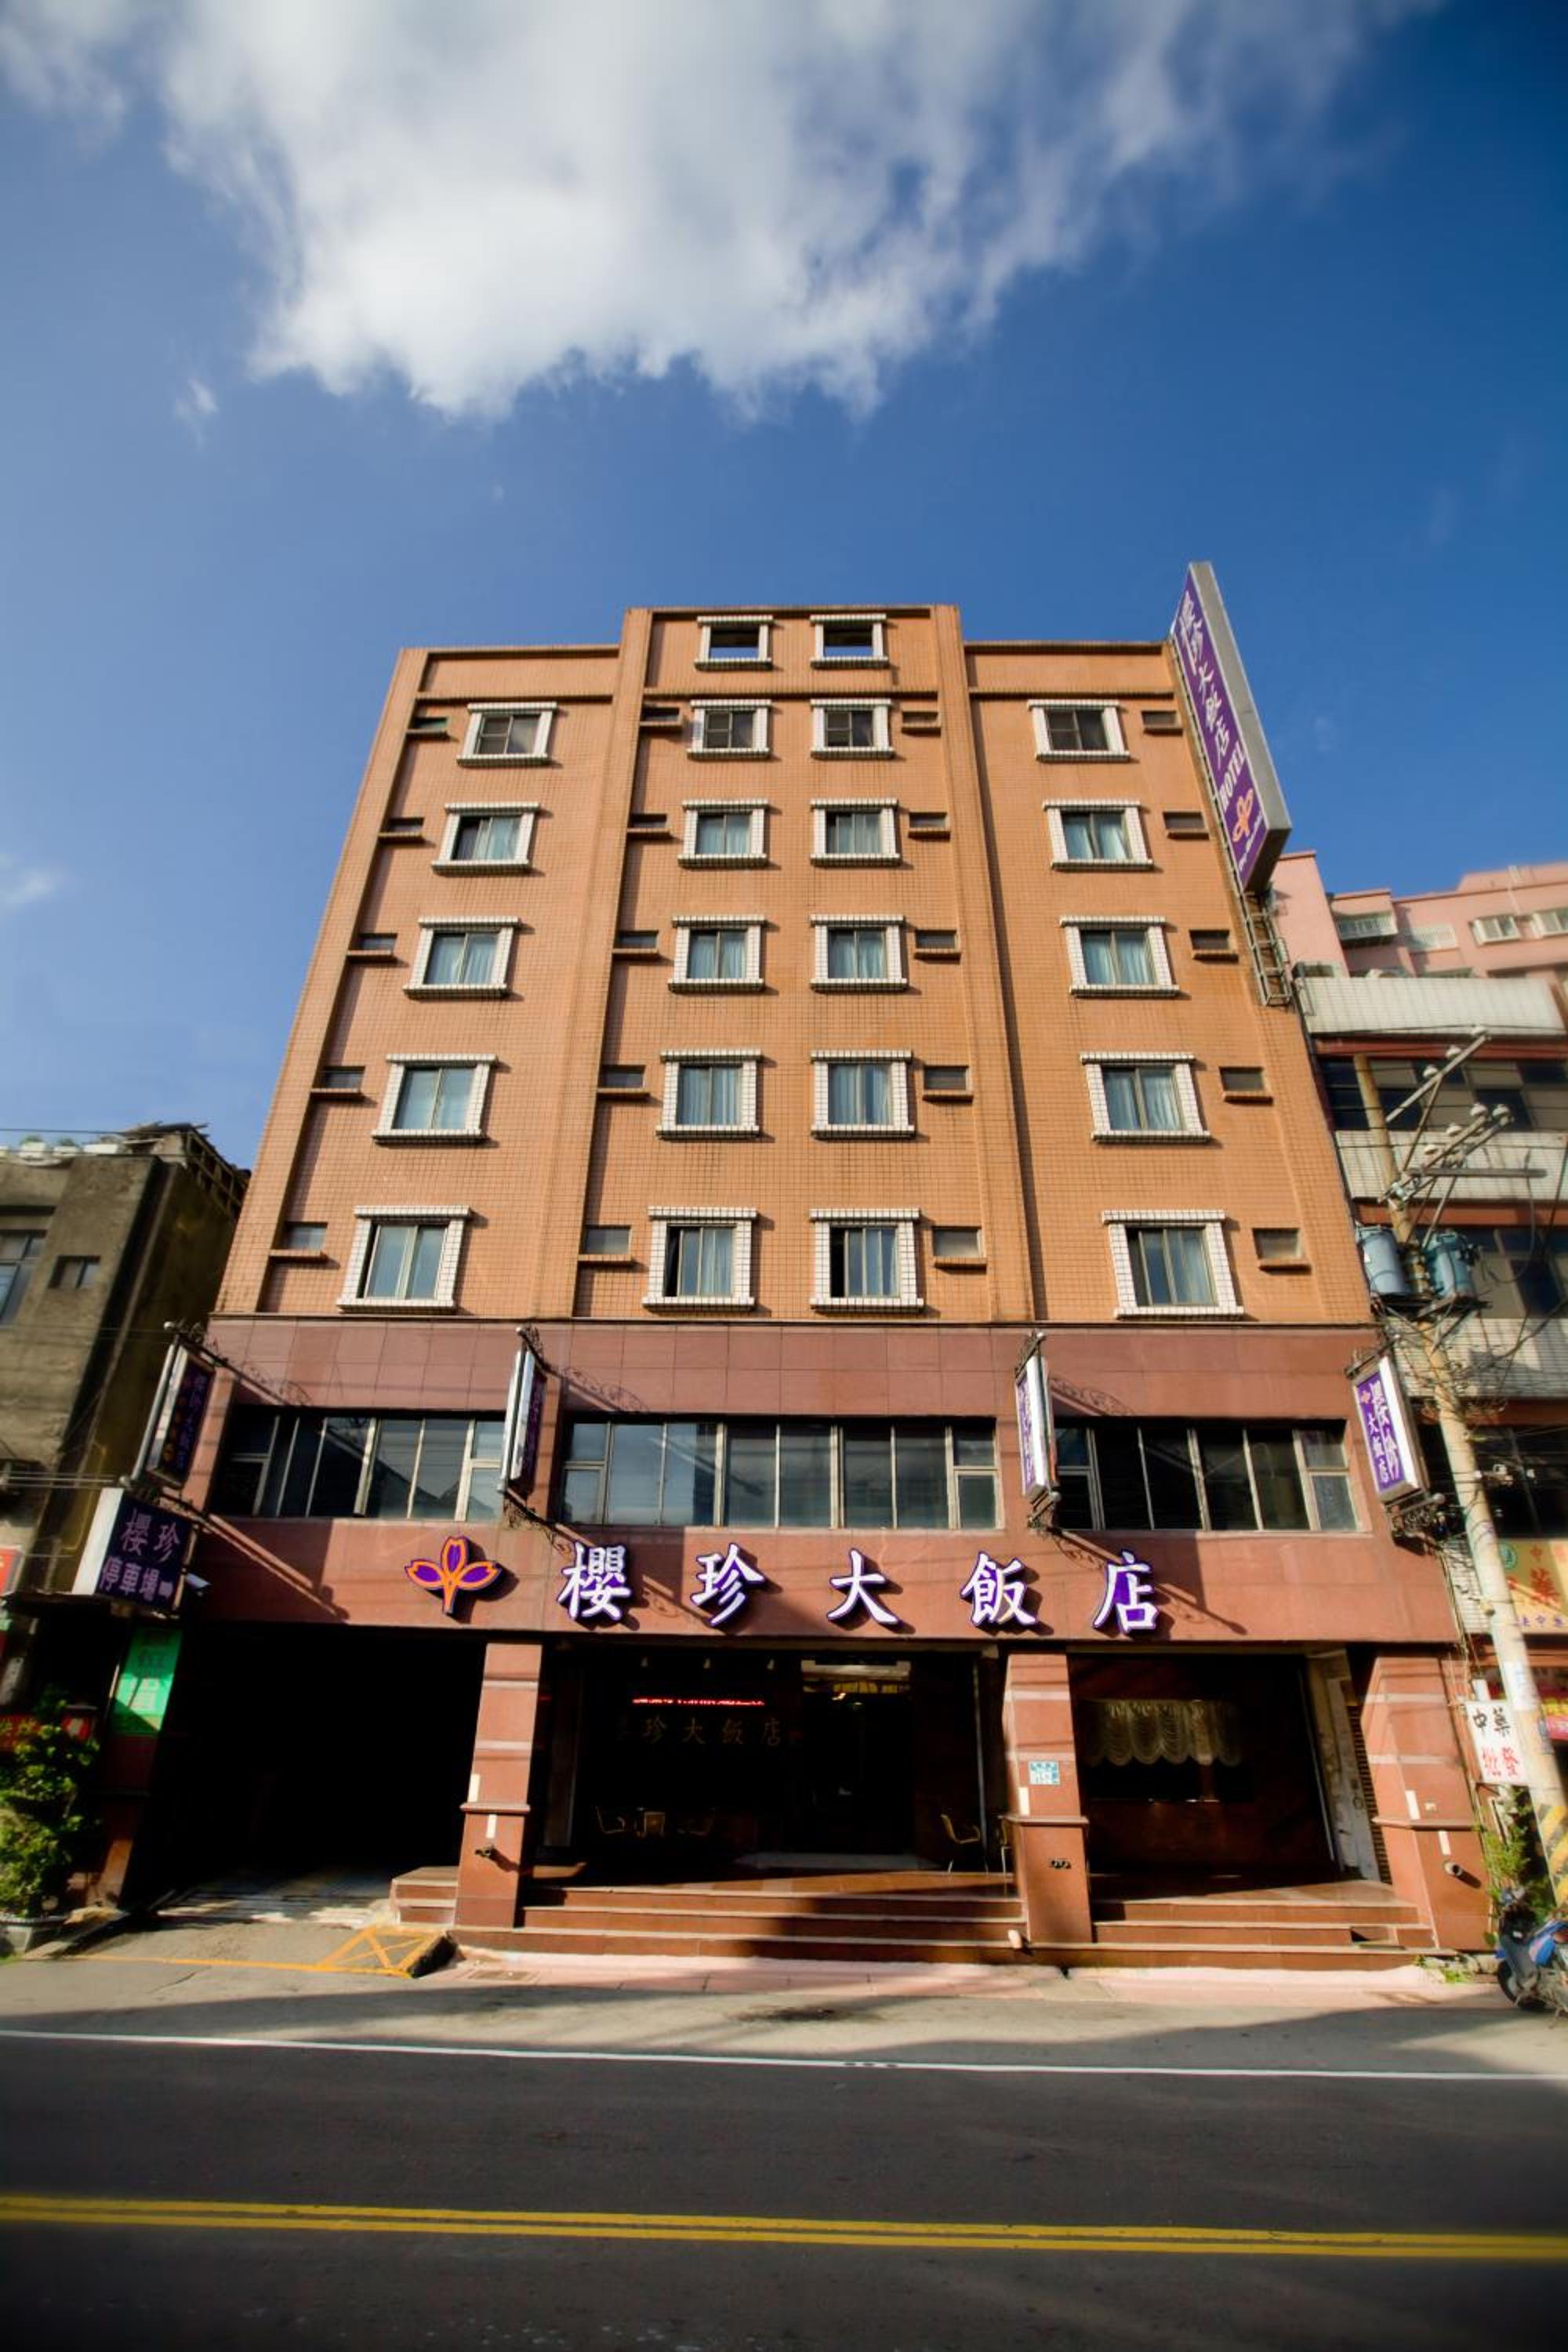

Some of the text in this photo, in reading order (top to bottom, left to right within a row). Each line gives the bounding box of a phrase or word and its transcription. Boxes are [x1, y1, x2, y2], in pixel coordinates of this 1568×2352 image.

[1219, 740, 1245, 812] HOTEL
[100, 1555, 160, 1602] 停車場
[557, 1542, 1159, 1633] 櫻珍大飯店
